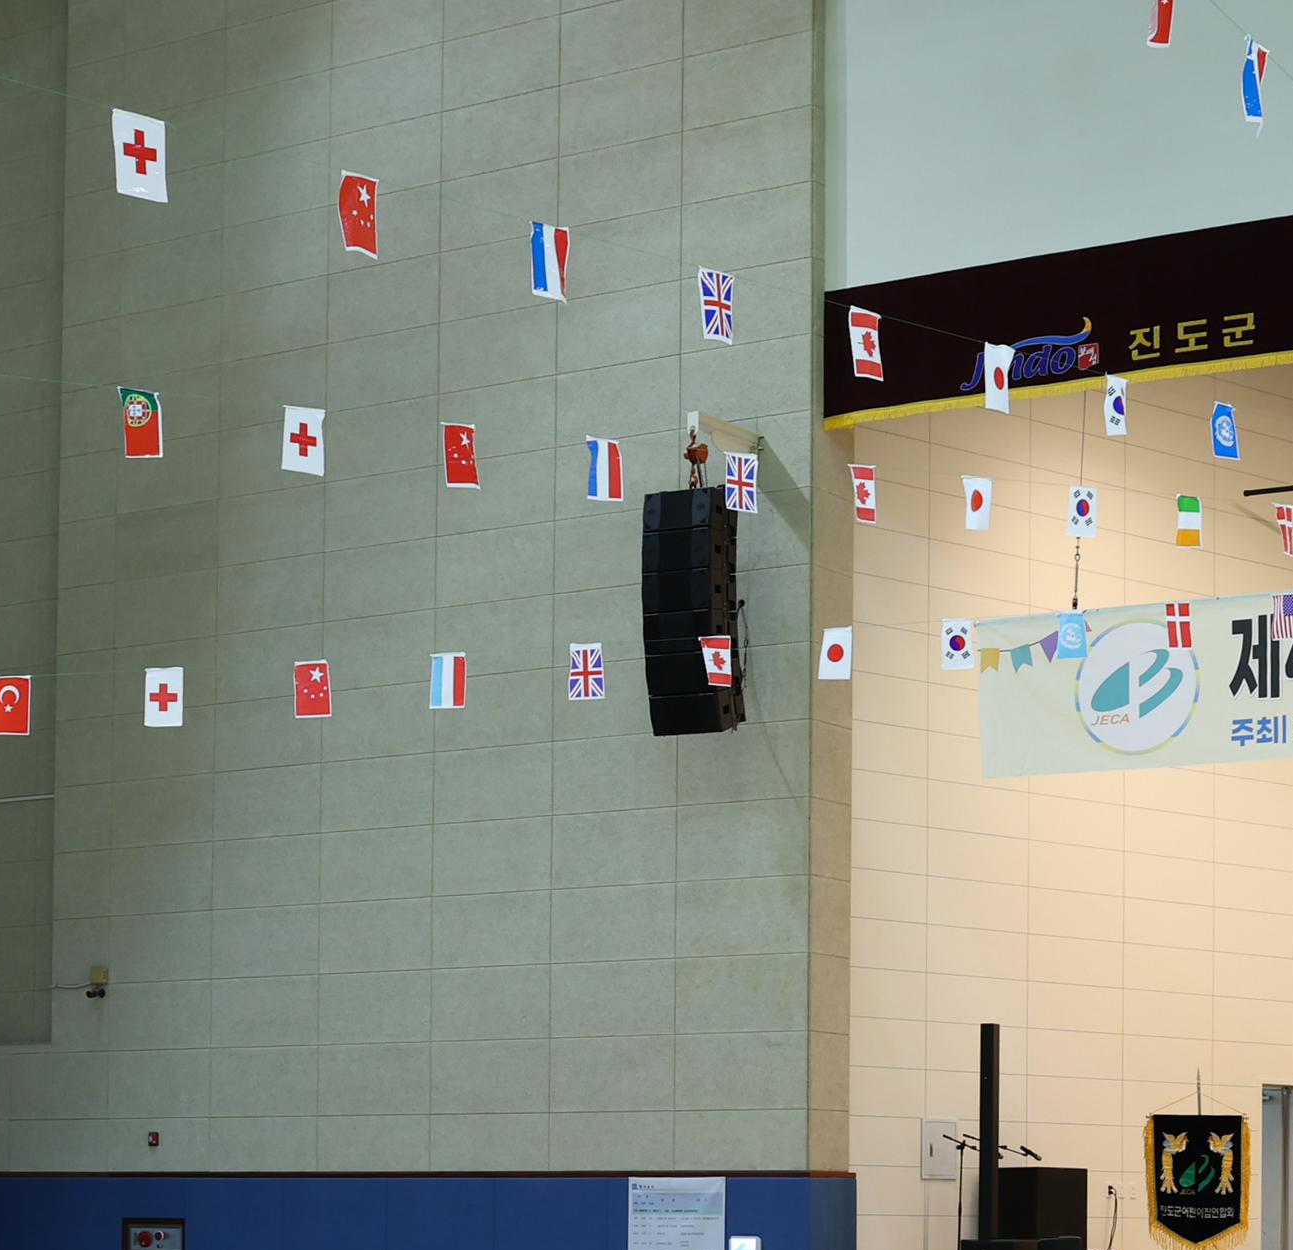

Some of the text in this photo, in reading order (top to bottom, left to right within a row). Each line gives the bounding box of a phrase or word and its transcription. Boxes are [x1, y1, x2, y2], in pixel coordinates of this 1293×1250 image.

[1128, 312, 1256, 361] 진도군
[960, 344, 1077, 391] Jndo
[1090, 713, 1130, 726] JECA
[1160, 1205, 1235, 1219] 진도군어린이집연합회
